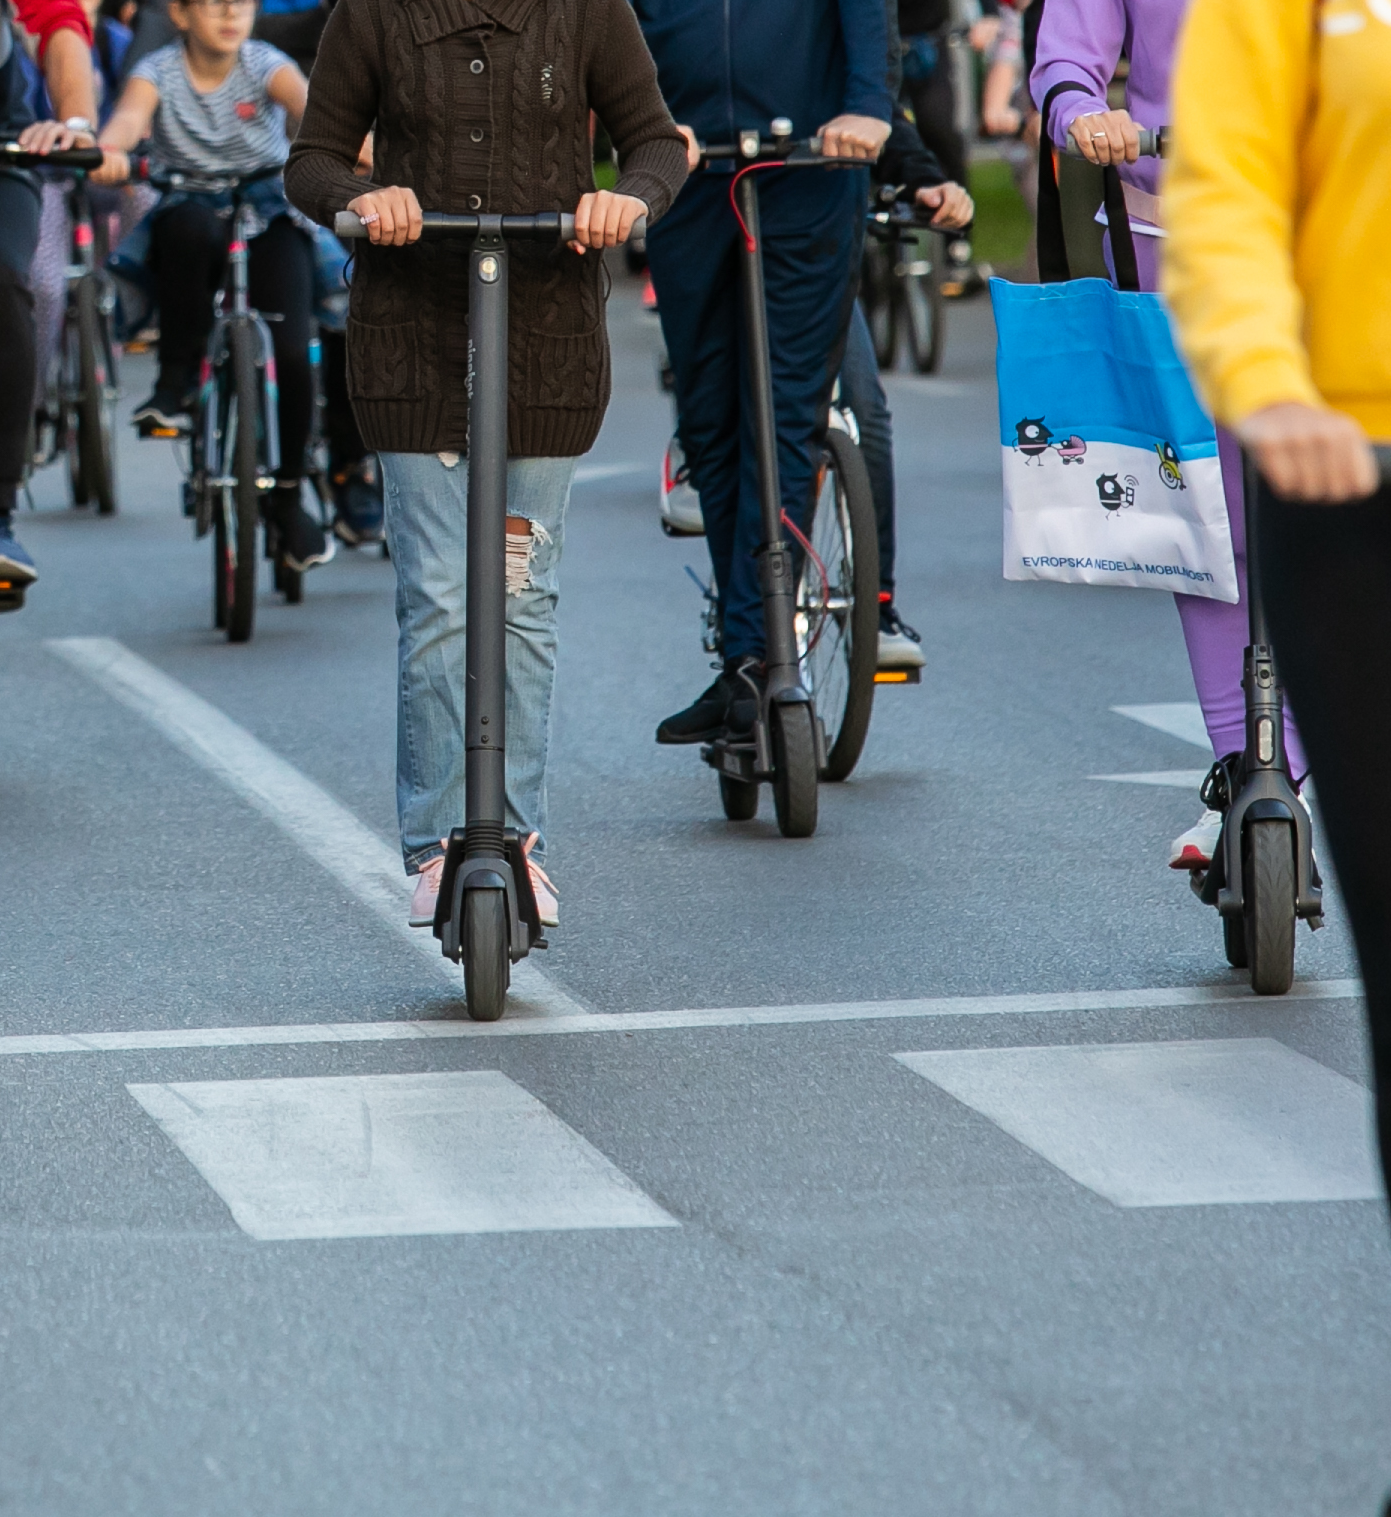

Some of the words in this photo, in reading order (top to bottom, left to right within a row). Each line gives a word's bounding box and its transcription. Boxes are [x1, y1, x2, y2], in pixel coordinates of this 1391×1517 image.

[1022, 556, 1093, 569] EVROPSKA
[1094, 559, 1145, 574] NEDELJA
[1145, 564, 1215, 583] MOBILNOSTI
